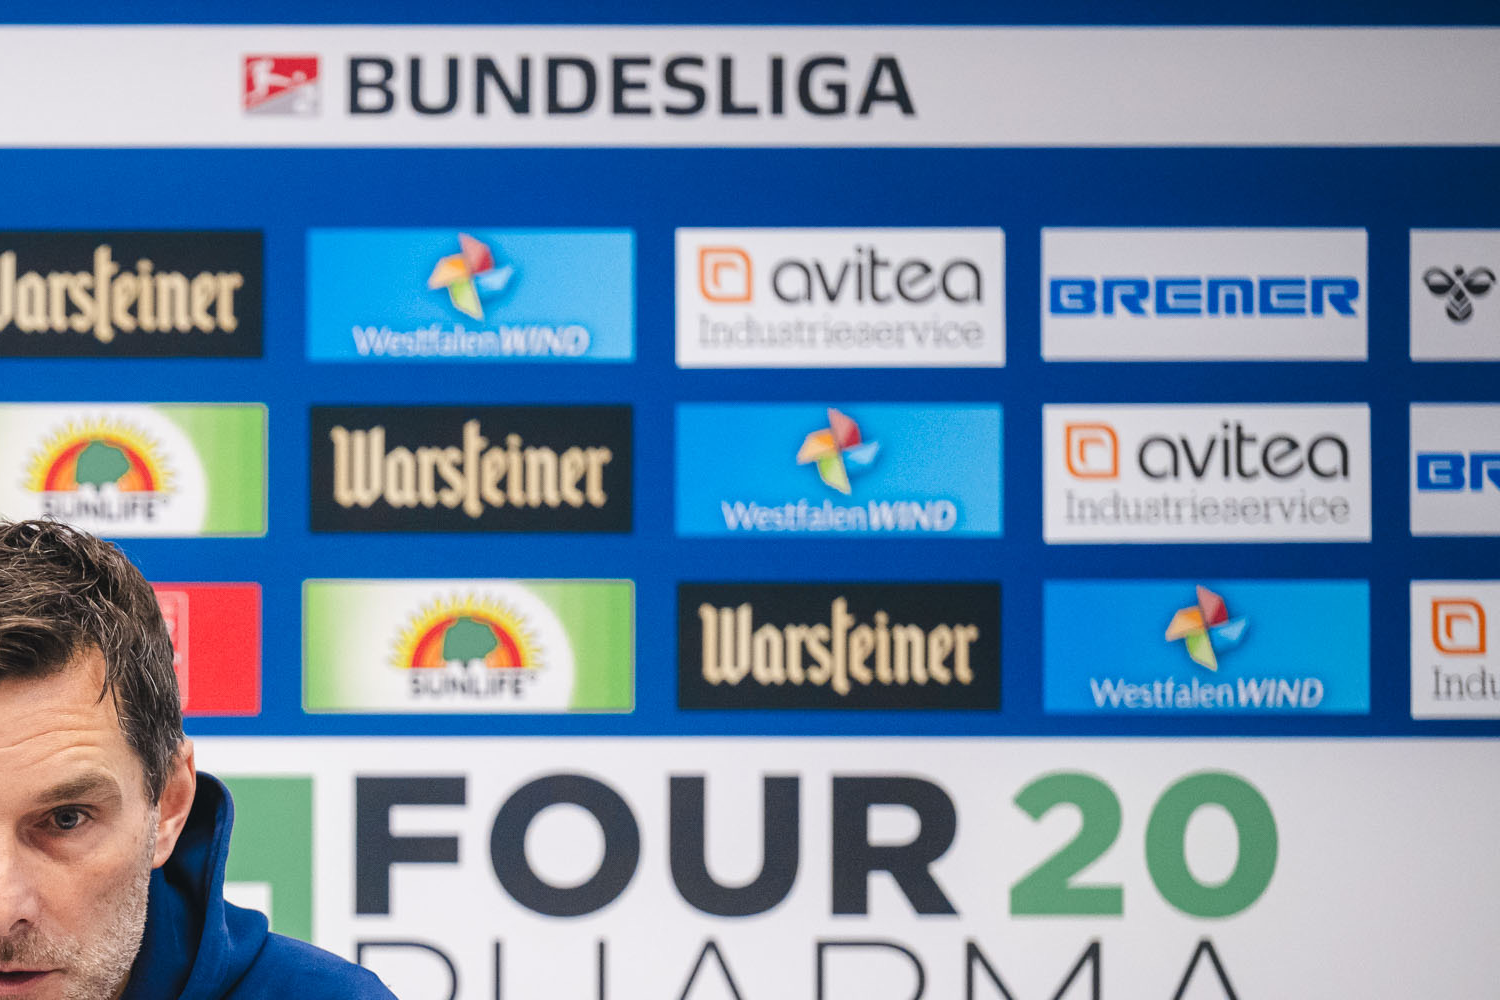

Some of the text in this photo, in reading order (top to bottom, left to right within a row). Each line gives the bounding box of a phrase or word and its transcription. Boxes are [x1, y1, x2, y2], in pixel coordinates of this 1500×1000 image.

[349, 55, 916, 117] BUNDESLIGA
[772, 247, 983, 304] avitea
[1049, 276, 1360, 317] BREMER
[699, 314, 985, 351] Industrieservice
[331, 420, 611, 517] Warsteiner
[1138, 422, 1349, 480] avitea
[1065, 490, 1351, 526] Industrieservice
[699, 598, 978, 695] Warsteiner
[409, 671, 524, 698] SUNLIFE
[1090, 676, 1324, 709] WestfalenWIND
[354, 770, 1279, 920] FOUR 20
